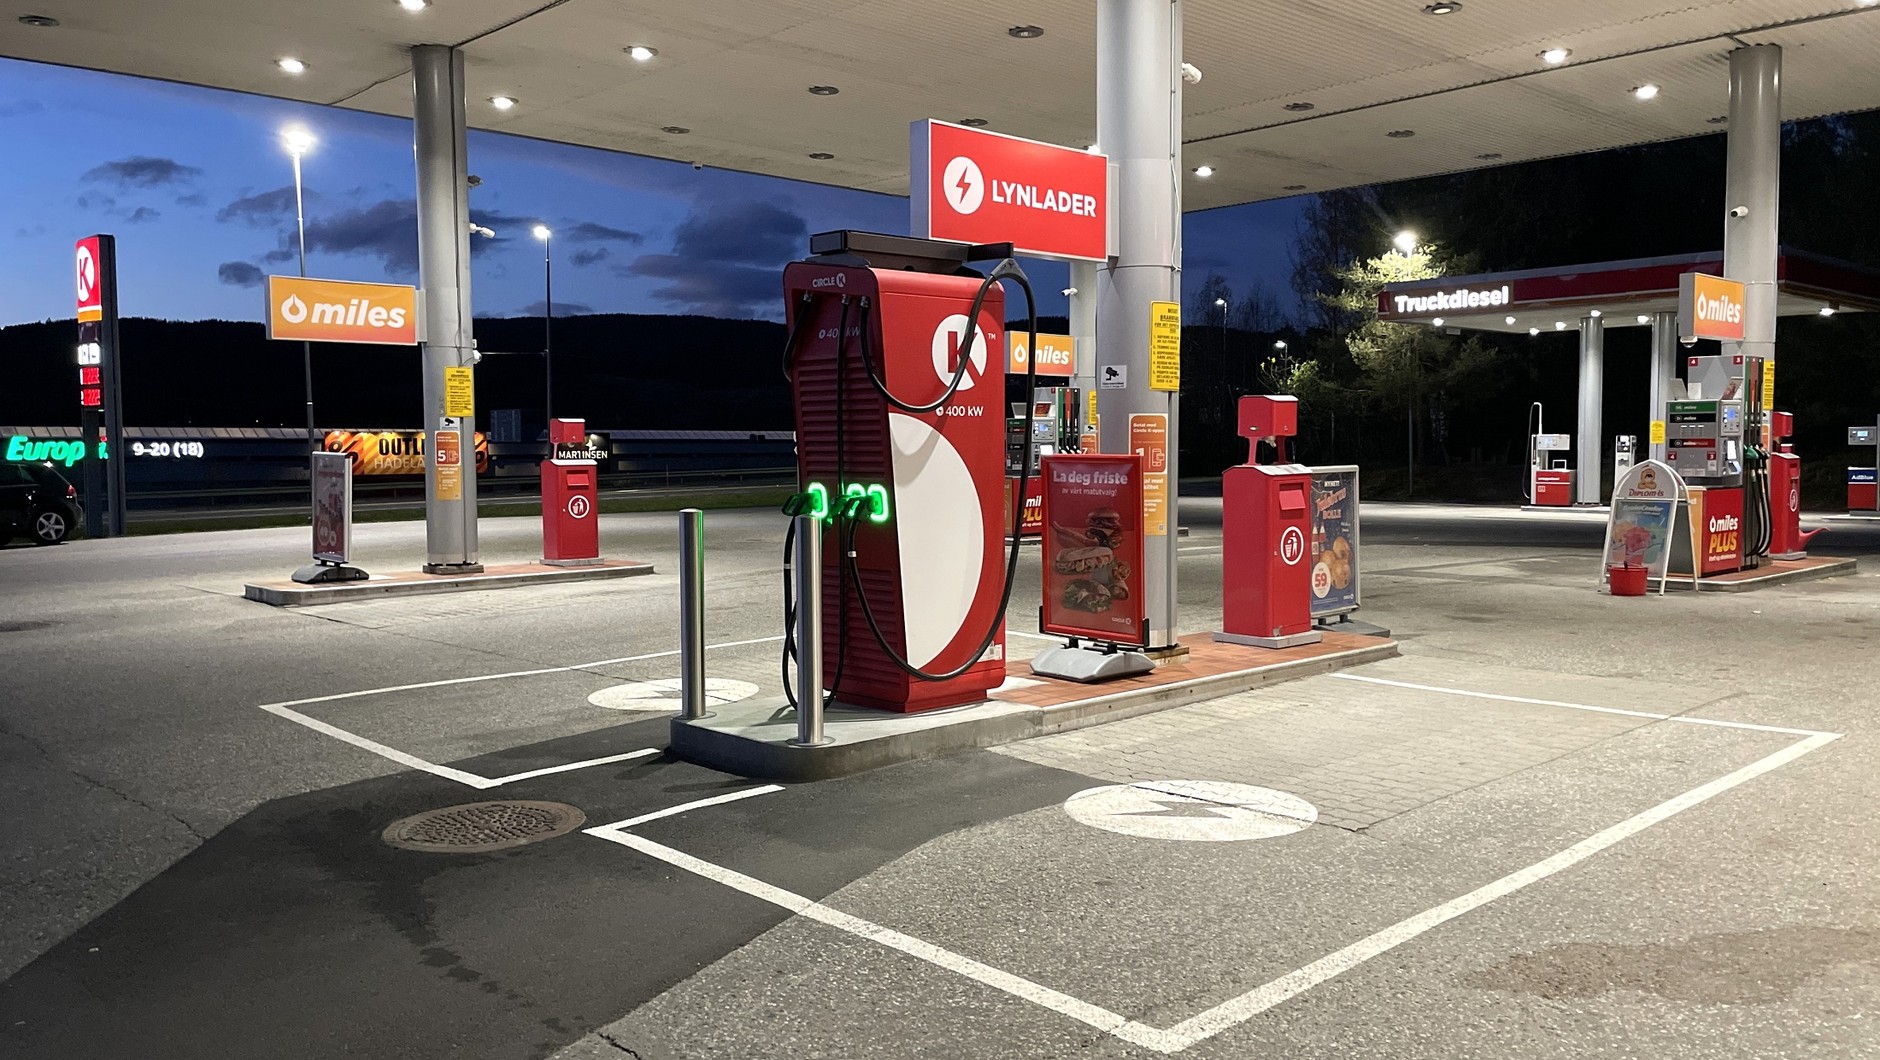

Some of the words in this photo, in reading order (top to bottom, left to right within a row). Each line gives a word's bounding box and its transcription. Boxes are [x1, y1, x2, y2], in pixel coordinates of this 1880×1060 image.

[992, 179, 1097, 218] LYNLADER
[812, 276, 836, 288] CIRCLE
[836, 273, 846, 288] K
[1394, 285, 1509, 313] Truckdiesel
[311, 299, 407, 328] miles
[1707, 295, 1742, 324] miles
[826, 326, 839, 338] 40
[945, 406, 966, 417] 400
[967, 406, 985, 417] kW
[172, 442, 204, 458] (18)
[437, 450, 447, 463] 5
[558, 450, 608, 460] MARTINSEN
[374, 456, 426, 469] HADELA
[1053, 470, 1067, 483] La
[1068, 471, 1091, 486] deg
[1093, 471, 1129, 485] friste
[1070, 486, 1082, 495] vårt
[1083, 488, 1117, 497] matutvalg!
[1025, 495, 1042, 507] mil
[1023, 508, 1042, 521] PLU
[1715, 514, 1739, 532] miles
[1708, 532, 1738, 554] PLUS
[1314, 573, 1328, 588] 59
